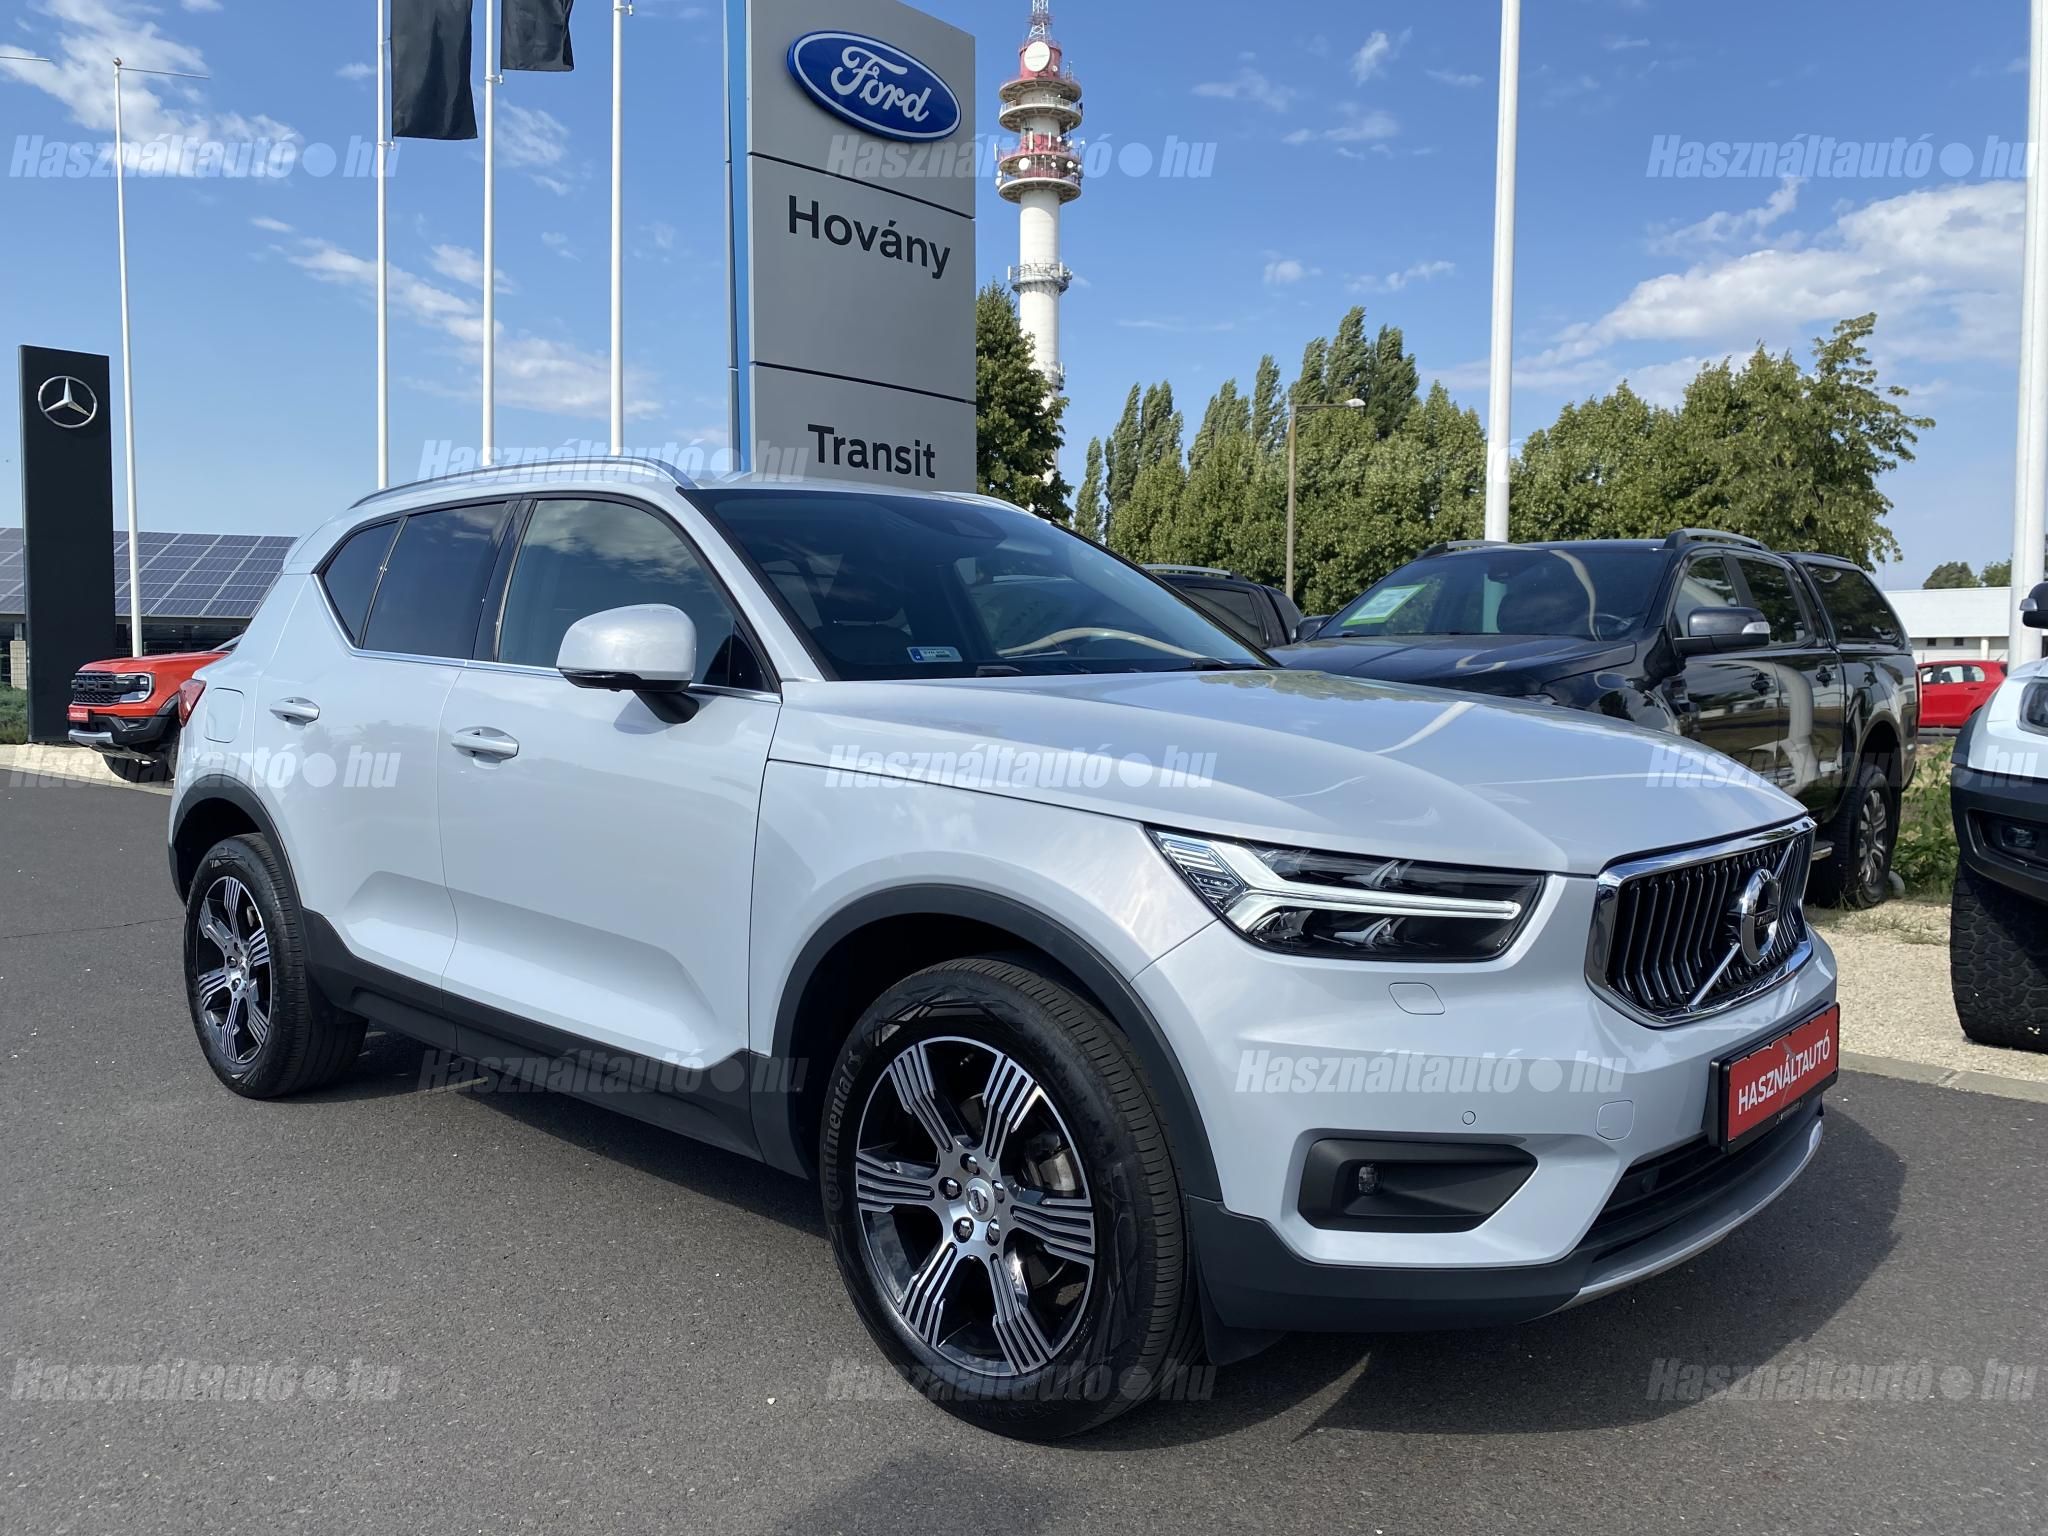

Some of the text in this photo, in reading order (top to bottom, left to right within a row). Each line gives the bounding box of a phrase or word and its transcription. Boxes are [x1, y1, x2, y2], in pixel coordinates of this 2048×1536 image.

[830, 46, 932, 122] Ford
[788, 195, 951, 280] Hovány
[807, 423, 936, 480] Transit
[1738, 1028, 1831, 1116] HASZNÁLTAUTÓ
